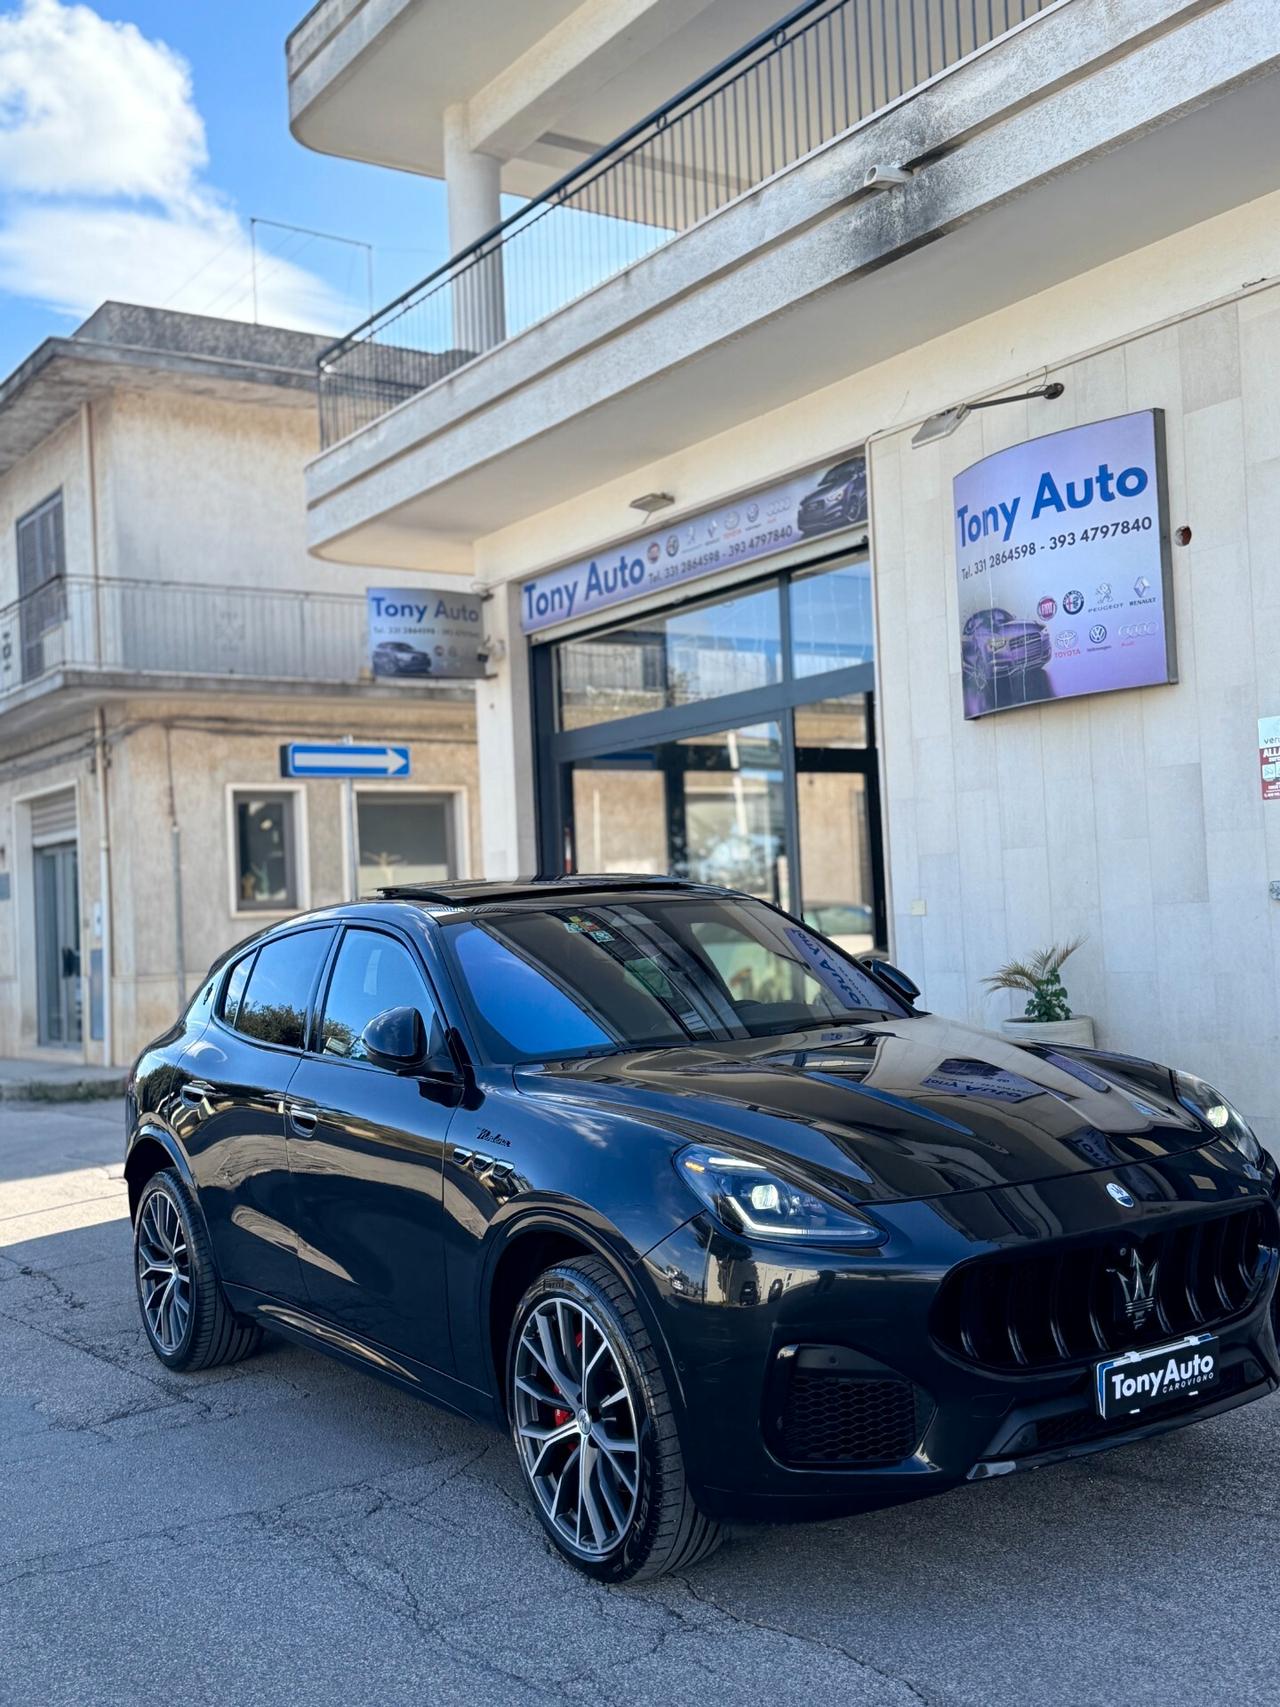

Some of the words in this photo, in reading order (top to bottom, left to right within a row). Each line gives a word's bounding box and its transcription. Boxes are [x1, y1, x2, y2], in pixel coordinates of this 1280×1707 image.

[957, 497, 1021, 547] Tony
[1031, 464, 1148, 520] Auto
[681, 550, 720, 574] 2864598
[728, 540, 746, 557] 393
[748, 525, 793, 549] 4797840
[961, 565, 973, 580] Tel.
[974, 558, 987, 575] 331
[989, 542, 1036, 569] 2864598
[1049, 532, 1076, 550] 393
[1080, 516, 1152, 542] 4797840
[371, 597, 427, 623] Tony
[434, 600, 479, 622] Auto
[524, 583, 578, 619] Tony
[584, 556, 645, 601] Auto
[1055, 648, 1081, 658] TOYOTA
[1112, 1354, 1214, 1400] TonyAuto
[1162, 1372, 1214, 1394] CAROVIGNO
